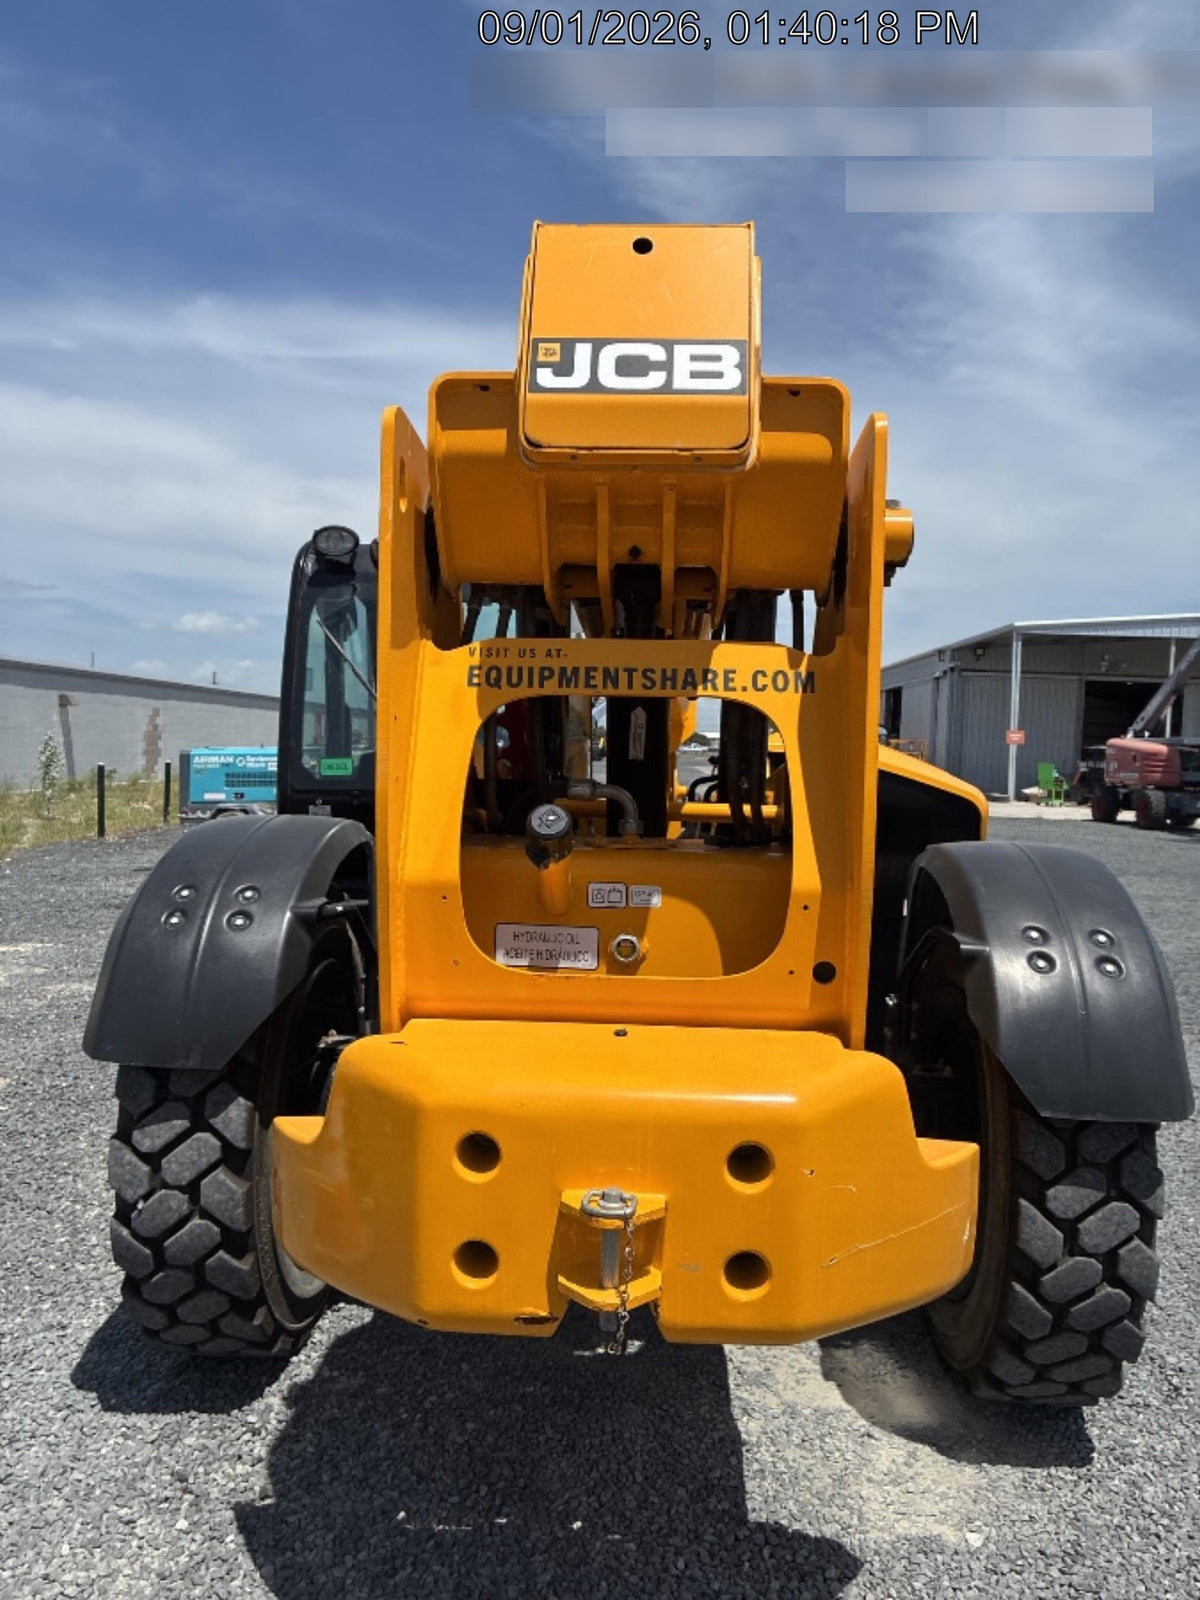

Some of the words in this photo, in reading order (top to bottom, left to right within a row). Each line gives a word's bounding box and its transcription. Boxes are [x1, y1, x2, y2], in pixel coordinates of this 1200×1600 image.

[536, 342, 742, 390] JCB
[468, 647, 510, 659] VISIT
[518, 648, 537, 659] US
[466, 664, 816, 695] EQUIPMENTSHARE.COM
[513, 930, 564, 944] HYDRAULIC
